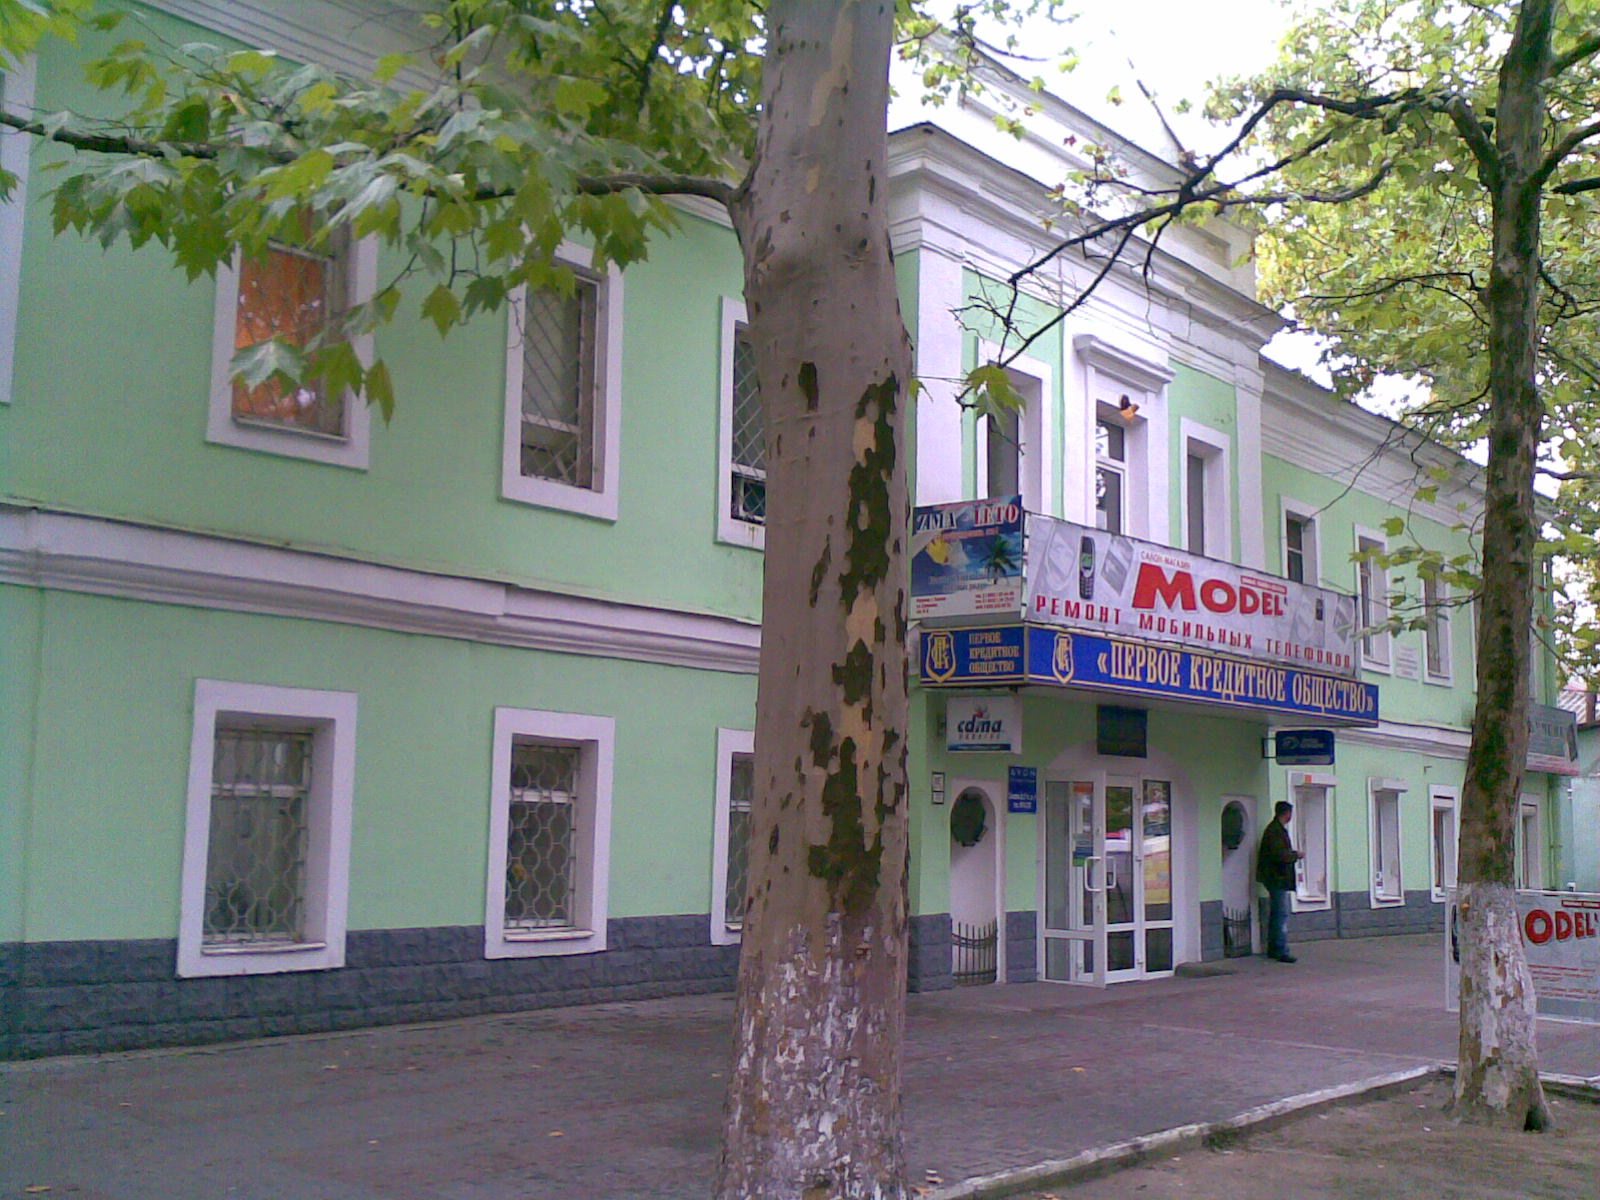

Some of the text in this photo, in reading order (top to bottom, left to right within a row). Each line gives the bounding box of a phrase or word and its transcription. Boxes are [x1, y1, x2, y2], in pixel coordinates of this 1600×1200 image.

[968, 632, 1001, 645] ПЕРВОЕ
[1036, 595, 1121, 625] РЕМОНТ
[1139, 613, 1252, 649] МОБИЛЬНЫХ
[1266, 638, 1351, 669] ТЕЛЕФОНОВ
[969, 645, 1020, 660] КРЕДИТНОЕ
[968, 660, 1015, 674] ОБЩЕСТВО
[1097, 641, 1181, 688] «ПЕРВОЕ
[1190, 655, 1286, 702] КРЕДИТНОЕ
[1293, 673, 1374, 714] ОБЩЕСТВО»
[957, 714, 1002, 733] cdma
